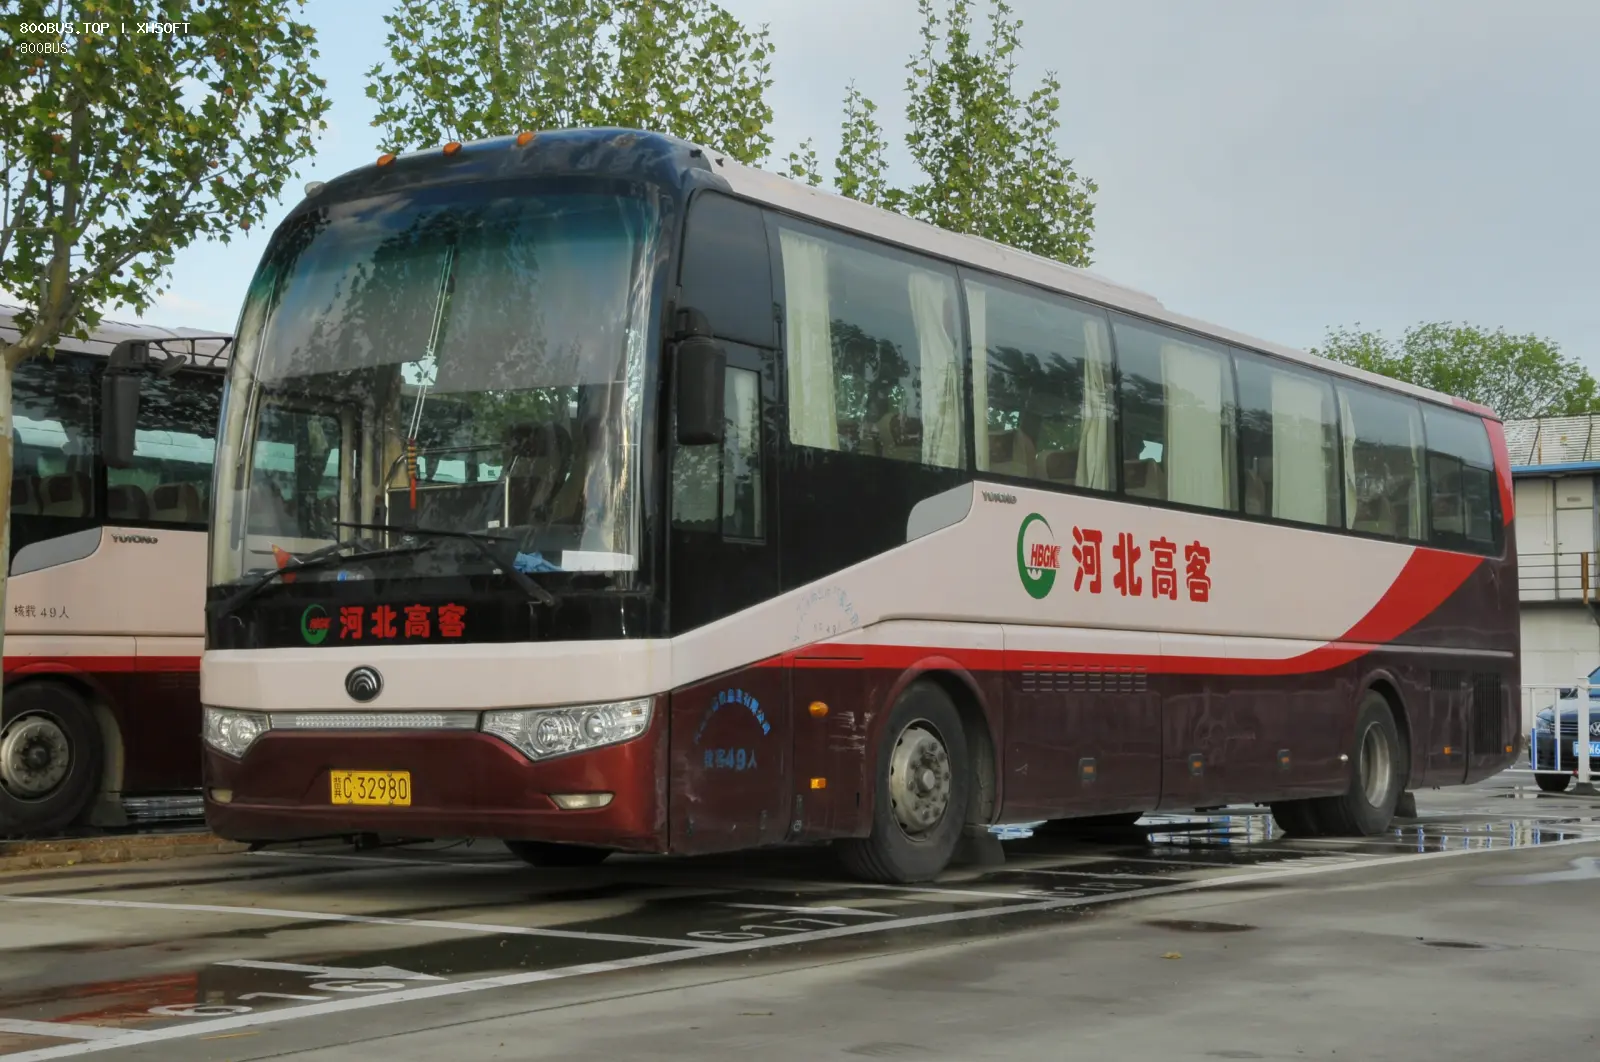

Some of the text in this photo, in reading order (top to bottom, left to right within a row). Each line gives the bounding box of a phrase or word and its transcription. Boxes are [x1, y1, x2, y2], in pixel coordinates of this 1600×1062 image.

[1071, 525, 1212, 603] 河北高客
[339, 603, 467, 639] 河北高客
